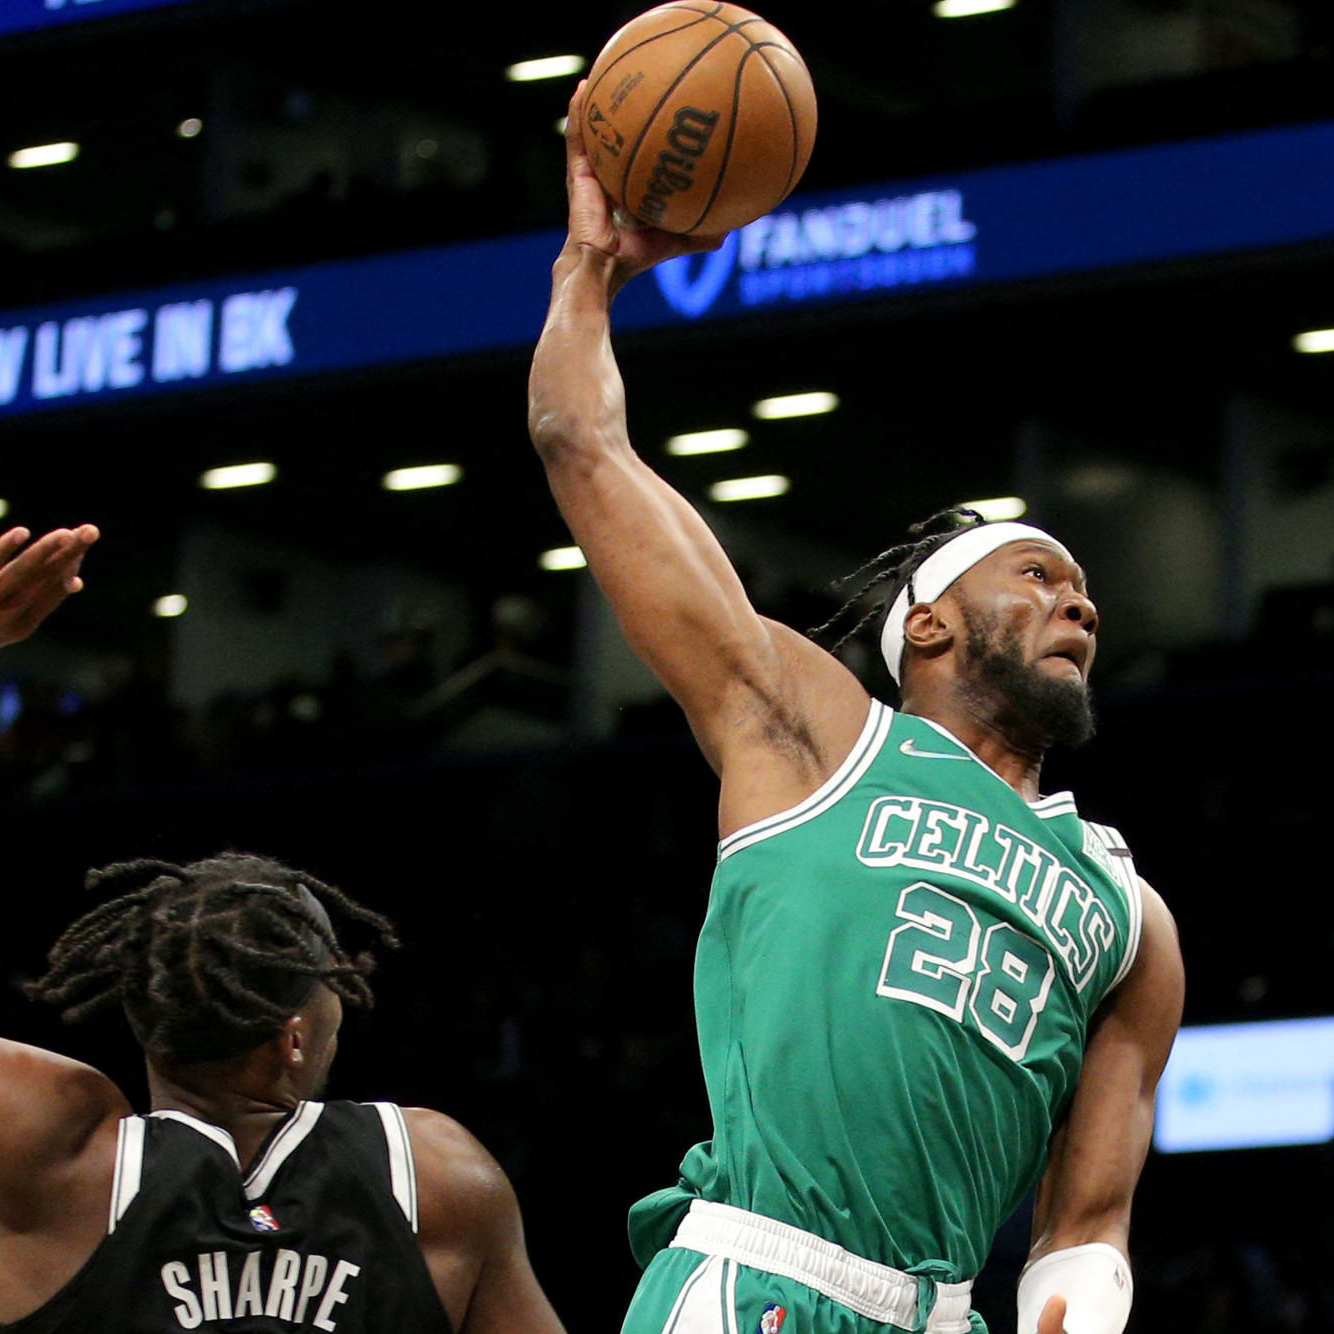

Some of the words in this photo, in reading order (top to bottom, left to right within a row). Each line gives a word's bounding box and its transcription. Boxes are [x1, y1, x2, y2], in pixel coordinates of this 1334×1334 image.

[32, 308, 148, 400] LIVE
[153, 299, 213, 383] IN
[218, 286, 298, 372] BK
[856, 795, 1115, 994] CELTICS
[876, 881, 1055, 1063] 28
[161, 1249, 360, 1332] SHARPE
